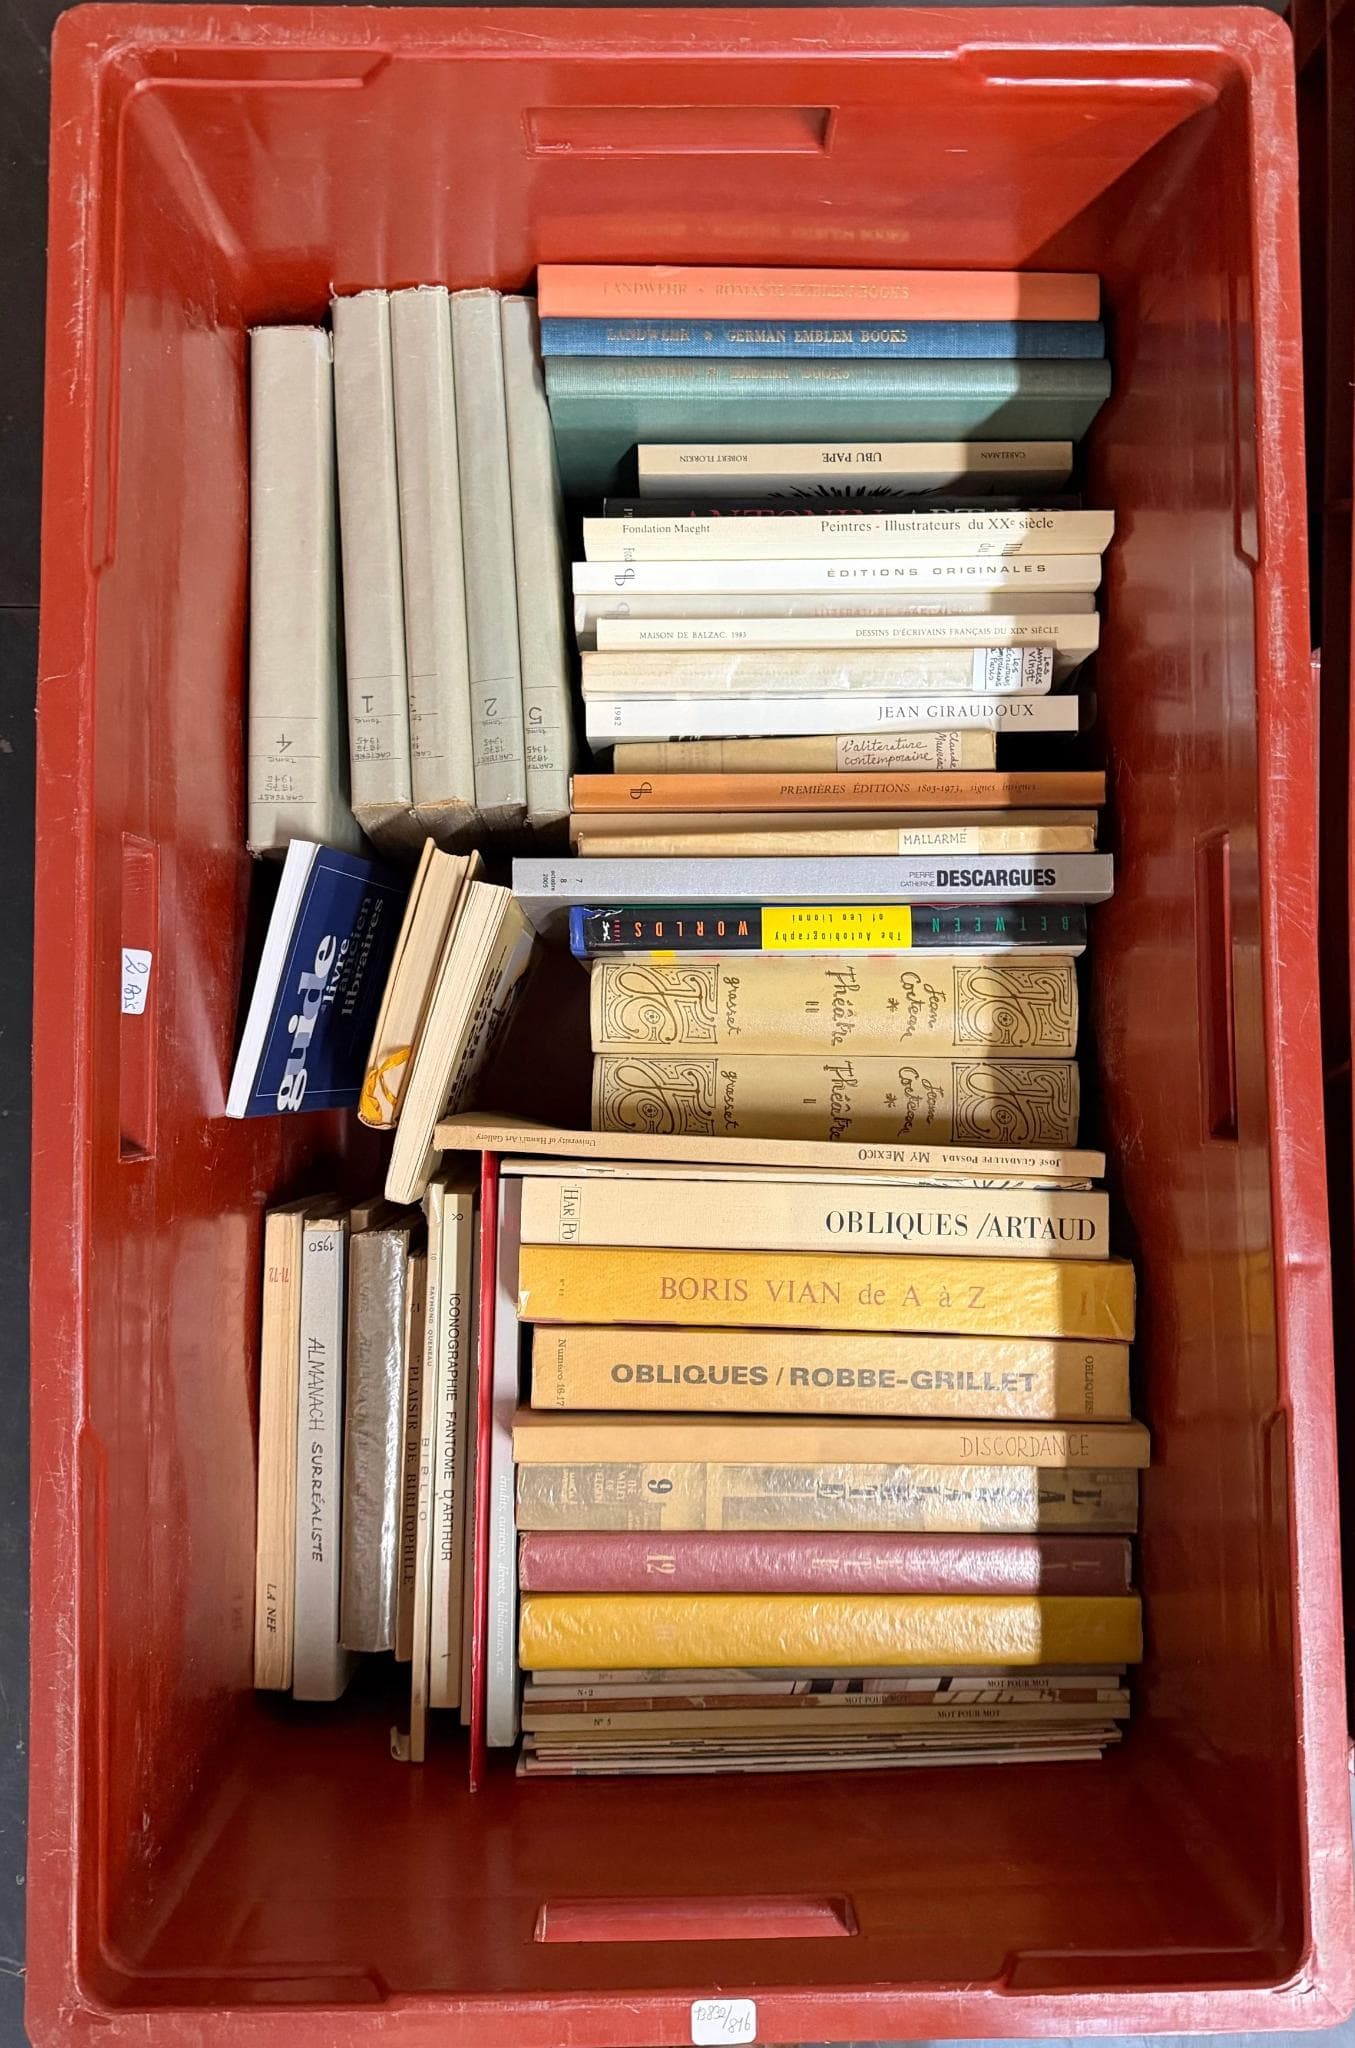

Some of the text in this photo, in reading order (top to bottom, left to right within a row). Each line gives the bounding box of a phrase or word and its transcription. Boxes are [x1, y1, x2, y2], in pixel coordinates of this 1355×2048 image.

[727, 329, 786, 343] GERMAN
[794, 329, 853, 343] EMBLEM
[860, 329, 907, 343] BOOKS
[679, 455, 748, 463] ROBERT FLORKIN
[822, 452, 882, 463] UBU PAPE
[622, 524, 710, 535] Fondation Maeght
[821, 520, 873, 532] Peintres
[885, 519, 961, 531] Illustrateurs
[968, 517, 984, 530] du
[1019, 516, 1055, 529] siècle
[827, 564, 1047, 577] ÉDITIONS ORIGINALES
[640, 632, 673, 640] MAISON
[677, 632, 688, 640] DE
[856, 629, 889, 637] DESSINS
[949, 627, 991, 638] FRANÇAIS
[994, 628, 1007, 636] DU
[361, 695, 374, 714] 1
[484, 698, 498, 717] 2
[878, 704, 1035, 720] JEAN GIRAUDOUX
[528, 707, 543, 725] 5
[614, 706, 622, 727] 1982
[276, 733, 293, 754] 4
[949, 732, 960, 769] Claude
[844, 752, 934, 767] contemporaine
[258, 793, 305, 801] CARTERET
[780, 783, 846, 795] PREMIÈRES
[853, 782, 911, 794] ÉDITIONS
[970, 785, 995, 794] signes
[903, 829, 968, 845] MALLARMÉ
[937, 869, 1056, 887] DESCARGUES
[792, 913, 884, 924] of Leo Lionni
[932, 915, 1069, 933] BETWEEN
[634, 920, 748, 937] WORLDS
[775, 930, 902, 942] The Autobiography
[339, 898, 371, 992] ancien
[342, 899, 384, 1015] libraires
[322, 939, 350, 1004] livre
[277, 935, 337, 1112] guide
[475, 1133, 504, 1143] Gallery
[505, 1134, 518, 1143] Art
[548, 1135, 557, 1145] of
[557, 1135, 597, 1147] University
[858, 1149, 930, 1163] MY MEXICO
[826, 1210, 969, 1240] OBLIQUES
[309, 1235, 335, 1252] 1950
[660, 1276, 986, 1309] BORIS VIAN de A à Z
[426, 1329, 434, 1367] QUENEAU
[446, 1292, 461, 1402] ICONOGRAPHIE
[611, 1363, 769, 1386] OBLIQUES
[1084, 1355, 1094, 1414] OBLIQUES
[307, 1337, 325, 1562] ALMANACH SURRÉALISTE
[407, 1442, 417, 1463] DE
[443, 1411, 457, 1480] FANTOME
[960, 1434, 1090, 1457] DISCORDANCE
[647, 1477, 673, 1495] 9
[646, 1551, 677, 1575] 12
[266, 1583, 277, 1633] LA NEF
[987, 1678, 1050, 1689] MOT POUR MOT
[937, 1709, 1001, 1719] MOT POUR MOT
